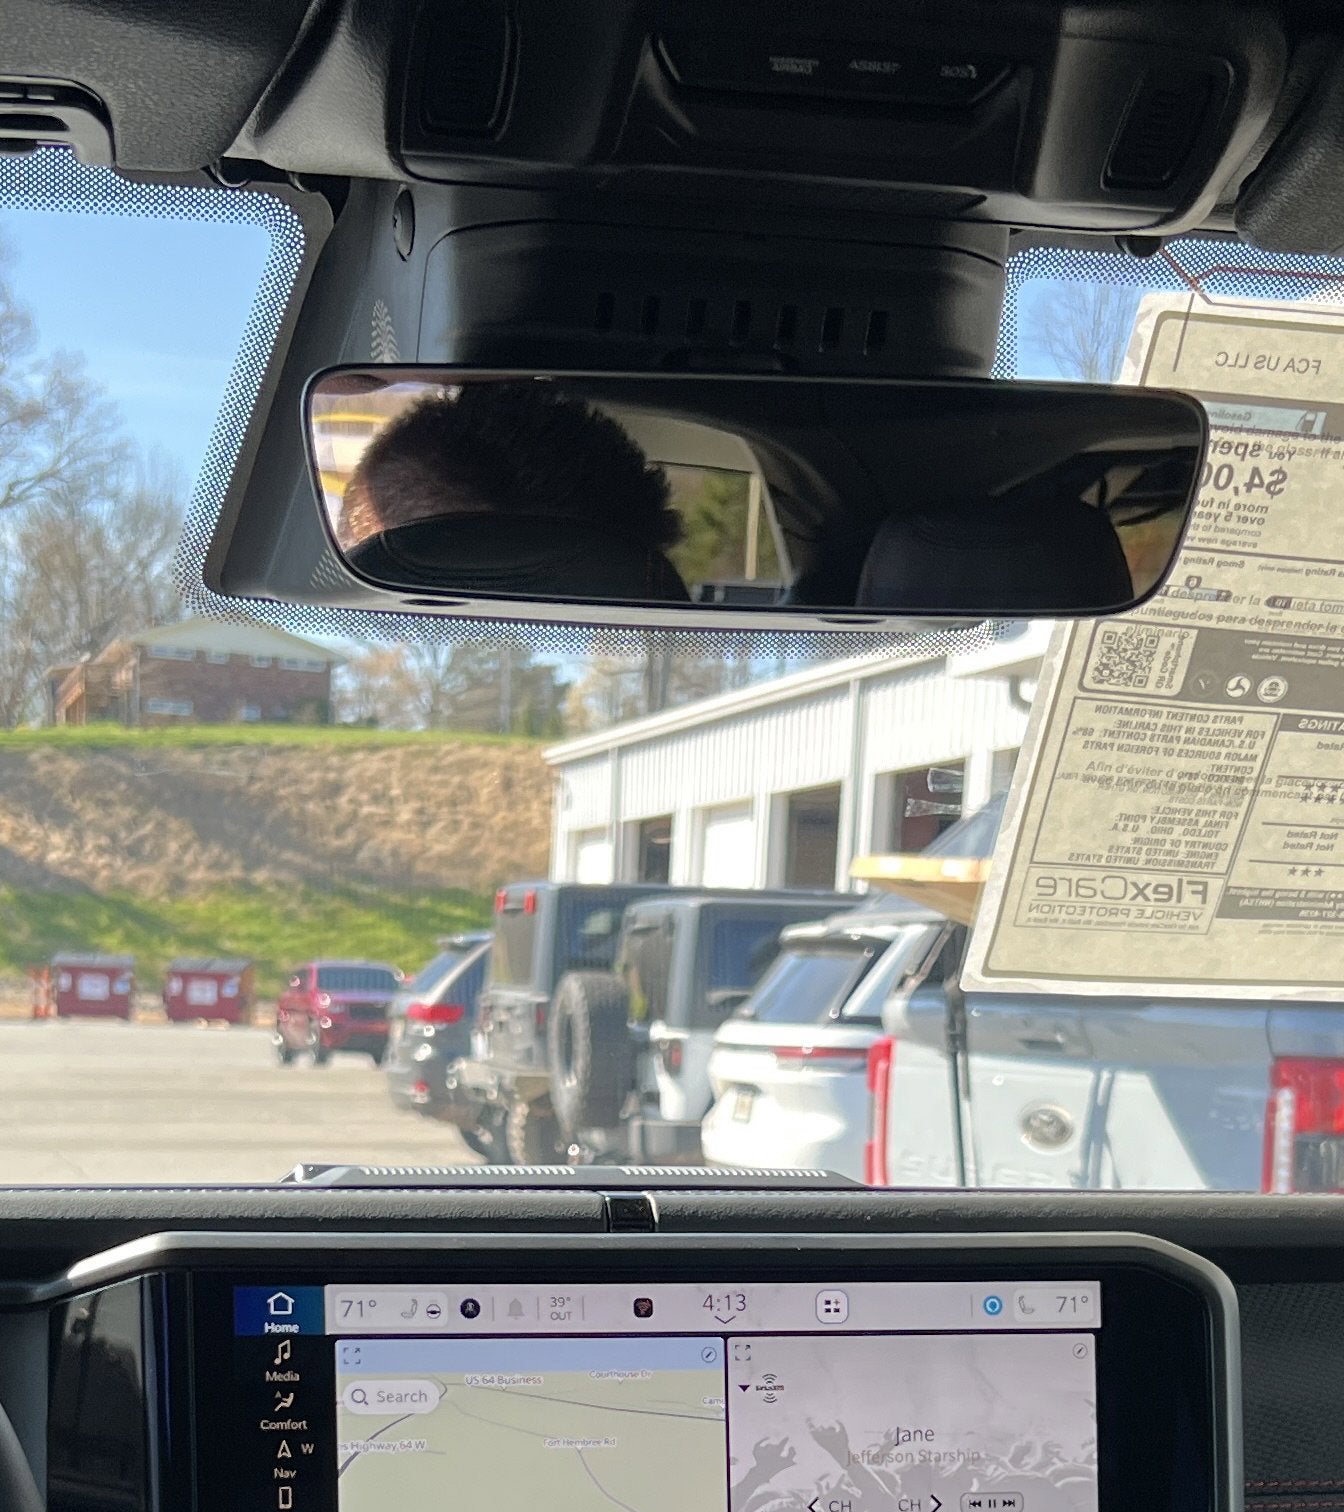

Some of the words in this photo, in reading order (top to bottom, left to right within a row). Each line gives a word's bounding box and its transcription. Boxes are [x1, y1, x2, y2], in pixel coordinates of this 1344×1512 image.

[549, 1296, 572, 1308] 39°
[702, 1294, 748, 1313] 4:13
[1056, 1295, 1089, 1314] 71°
[340, 1299, 378, 1319] 71°
[549, 1310, 573, 1322] OUT
[264, 1321, 300, 1334] Home
[265, 1369, 300, 1382] Media
[465, 1375, 480, 1385] US
[481, 1375, 496, 1385] 64
[497, 1374, 543, 1385] Business
[376, 1388, 428, 1404] Search
[260, 1418, 308, 1431] Comfort
[894, 1426, 935, 1446] Jane
[301, 1443, 315, 1455] W
[350, 1439, 399, 1453] Highway
[399, 1440, 413, 1451] 64
[414, 1440, 427, 1450] W
[846, 1449, 914, 1467] Jefferson
[918, 1448, 981, 1465] Starship
[273, 1467, 297, 1479] Nav
[898, 1499, 922, 1512] CH
